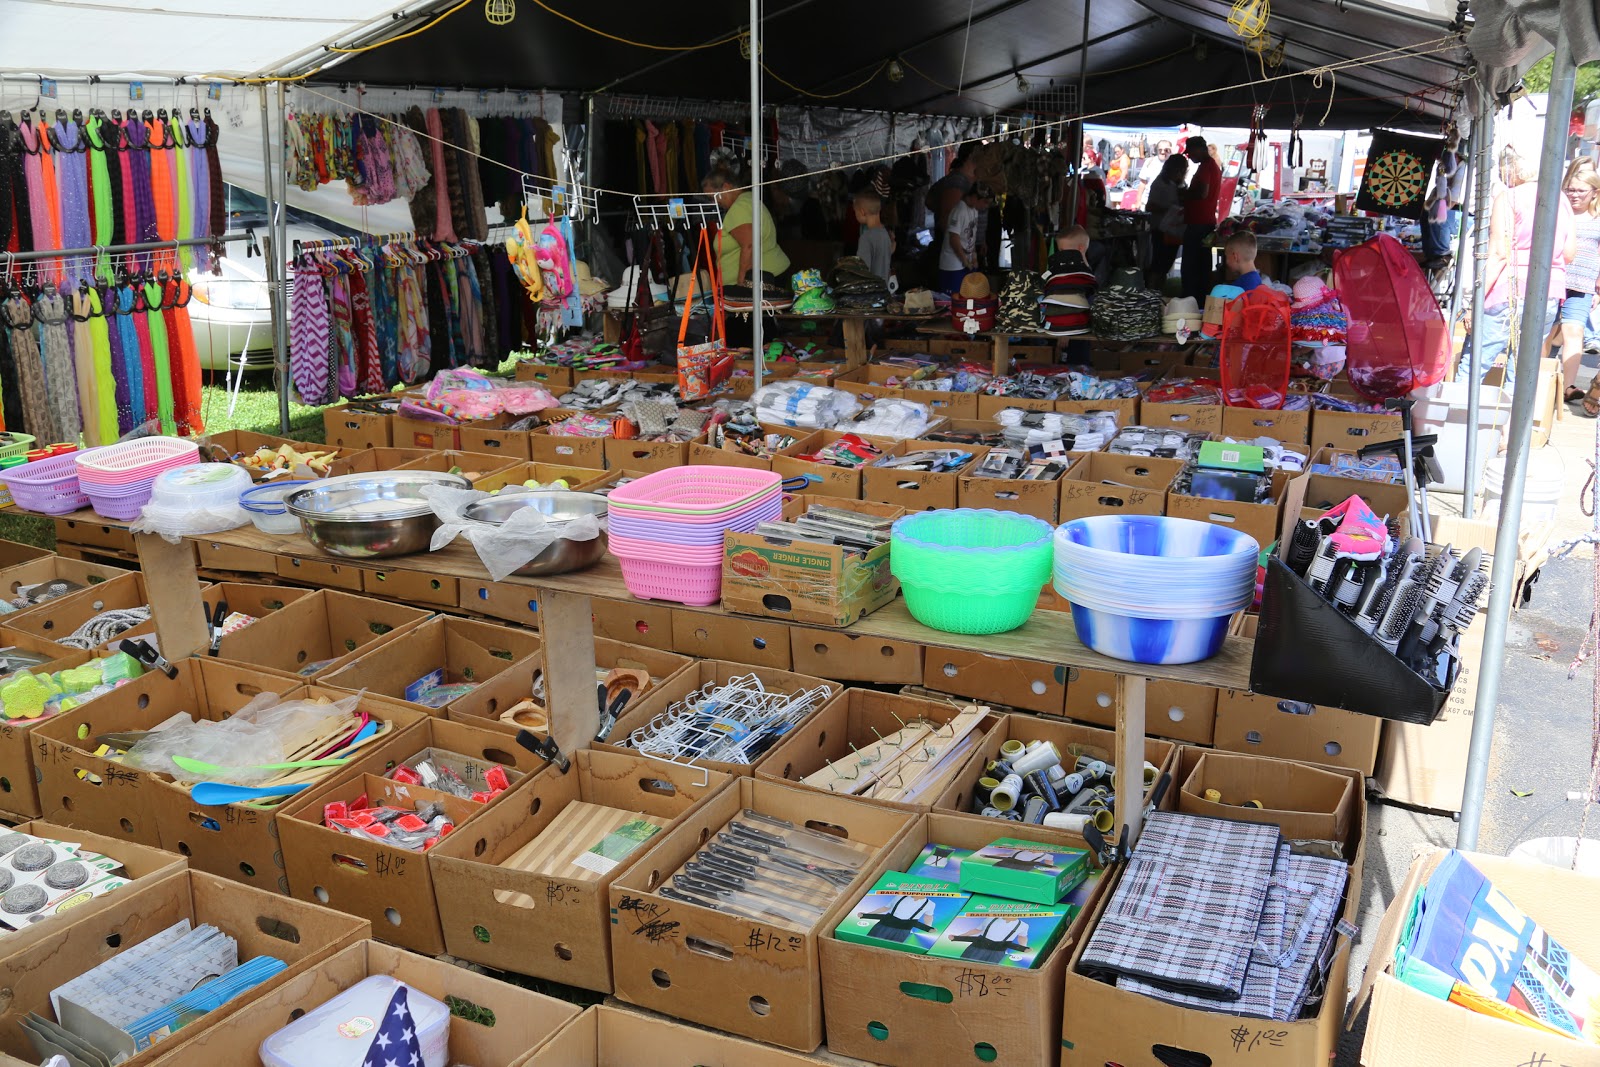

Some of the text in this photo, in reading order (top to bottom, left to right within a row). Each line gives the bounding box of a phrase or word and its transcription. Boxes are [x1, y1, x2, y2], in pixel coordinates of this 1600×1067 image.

[773, 552, 830, 567] SINGLE FINGER
[1449, 697, 1465, 705] KGS
